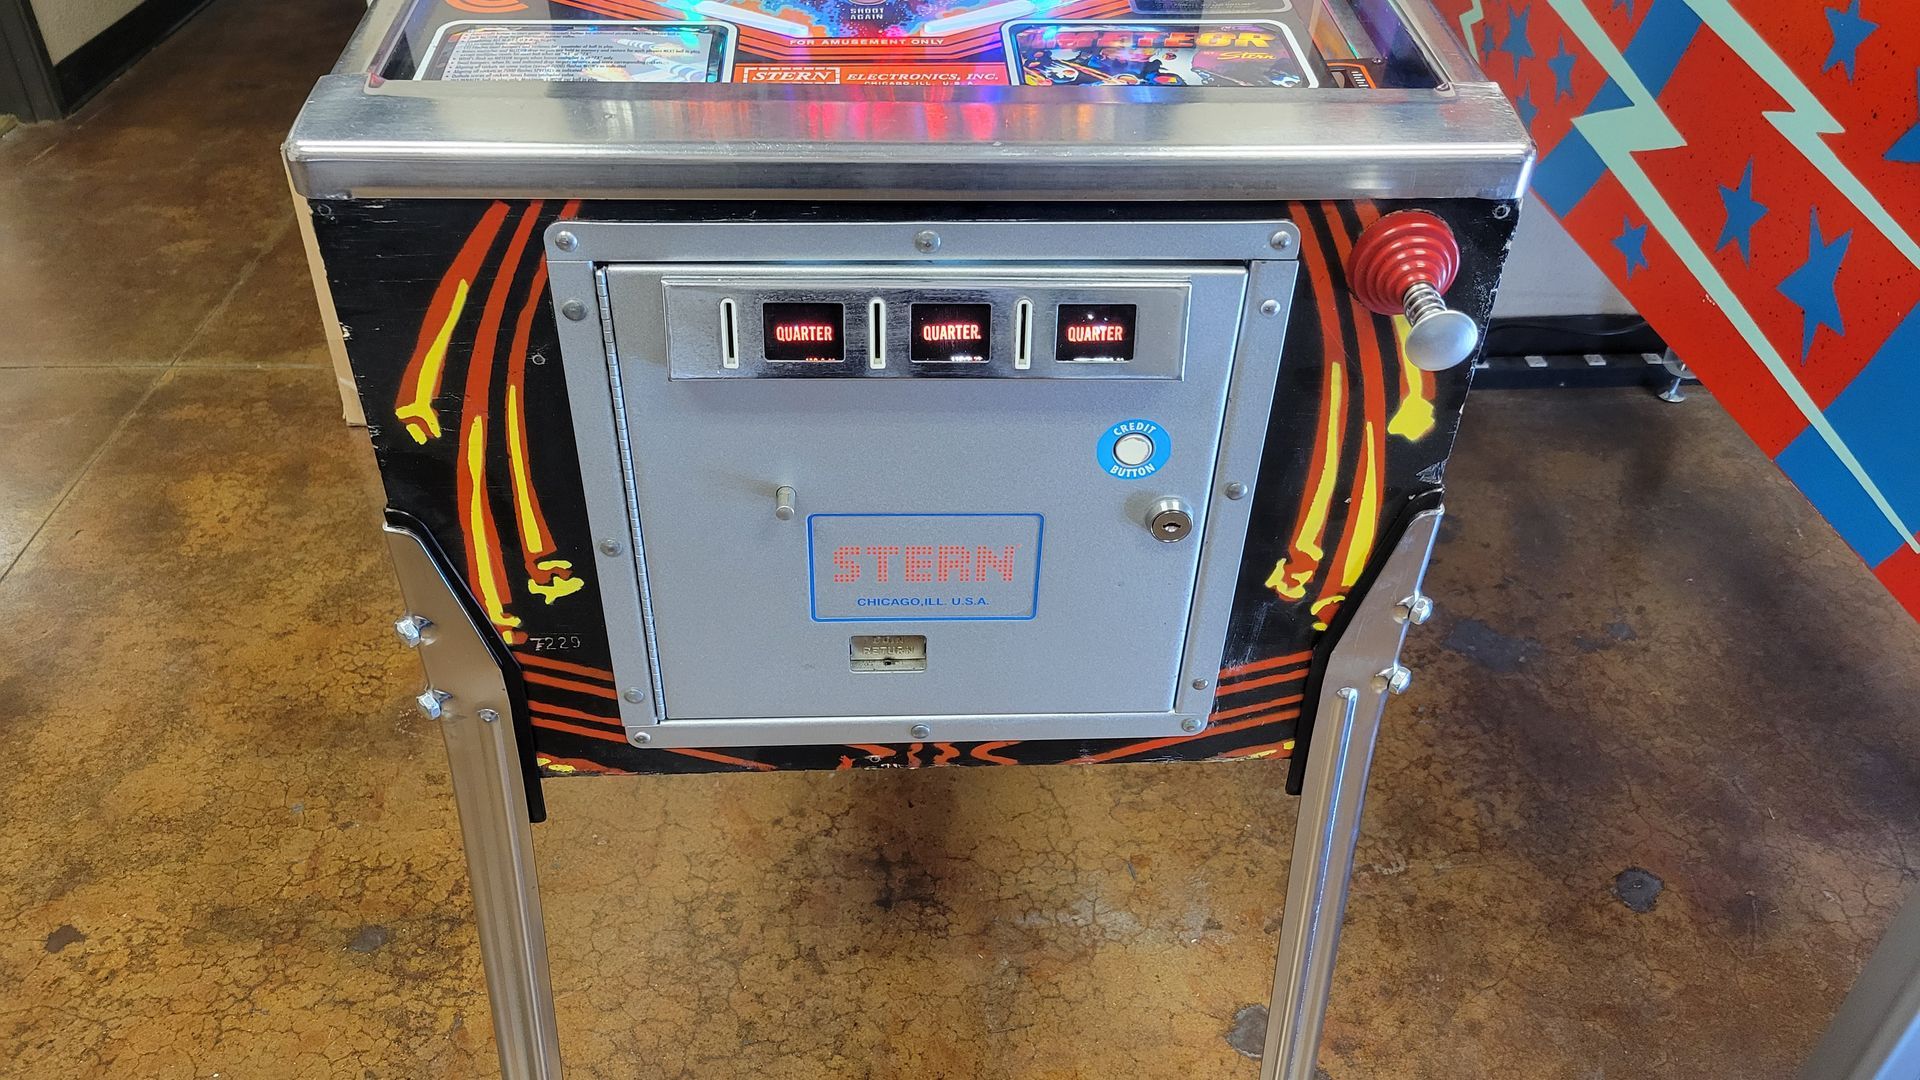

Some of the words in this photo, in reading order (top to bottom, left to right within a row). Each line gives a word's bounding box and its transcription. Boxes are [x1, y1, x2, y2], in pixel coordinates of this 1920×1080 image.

[751, 71, 832, 81] STERN
[846, 73, 961, 81] ELECTRONICS,
[966, 73, 999, 81] INC.
[776, 325, 833, 342] QUARTER
[1067, 325, 1123, 342] QUARTER
[1113, 422, 1157, 436] CREDIT
[1109, 462, 1156, 478] BUTTON
[832, 545, 1016, 583] STERN
[951, 597, 990, 606] U.S.A.
[873, 636, 904, 644] COIN
[863, 646, 915, 655] RETURN
